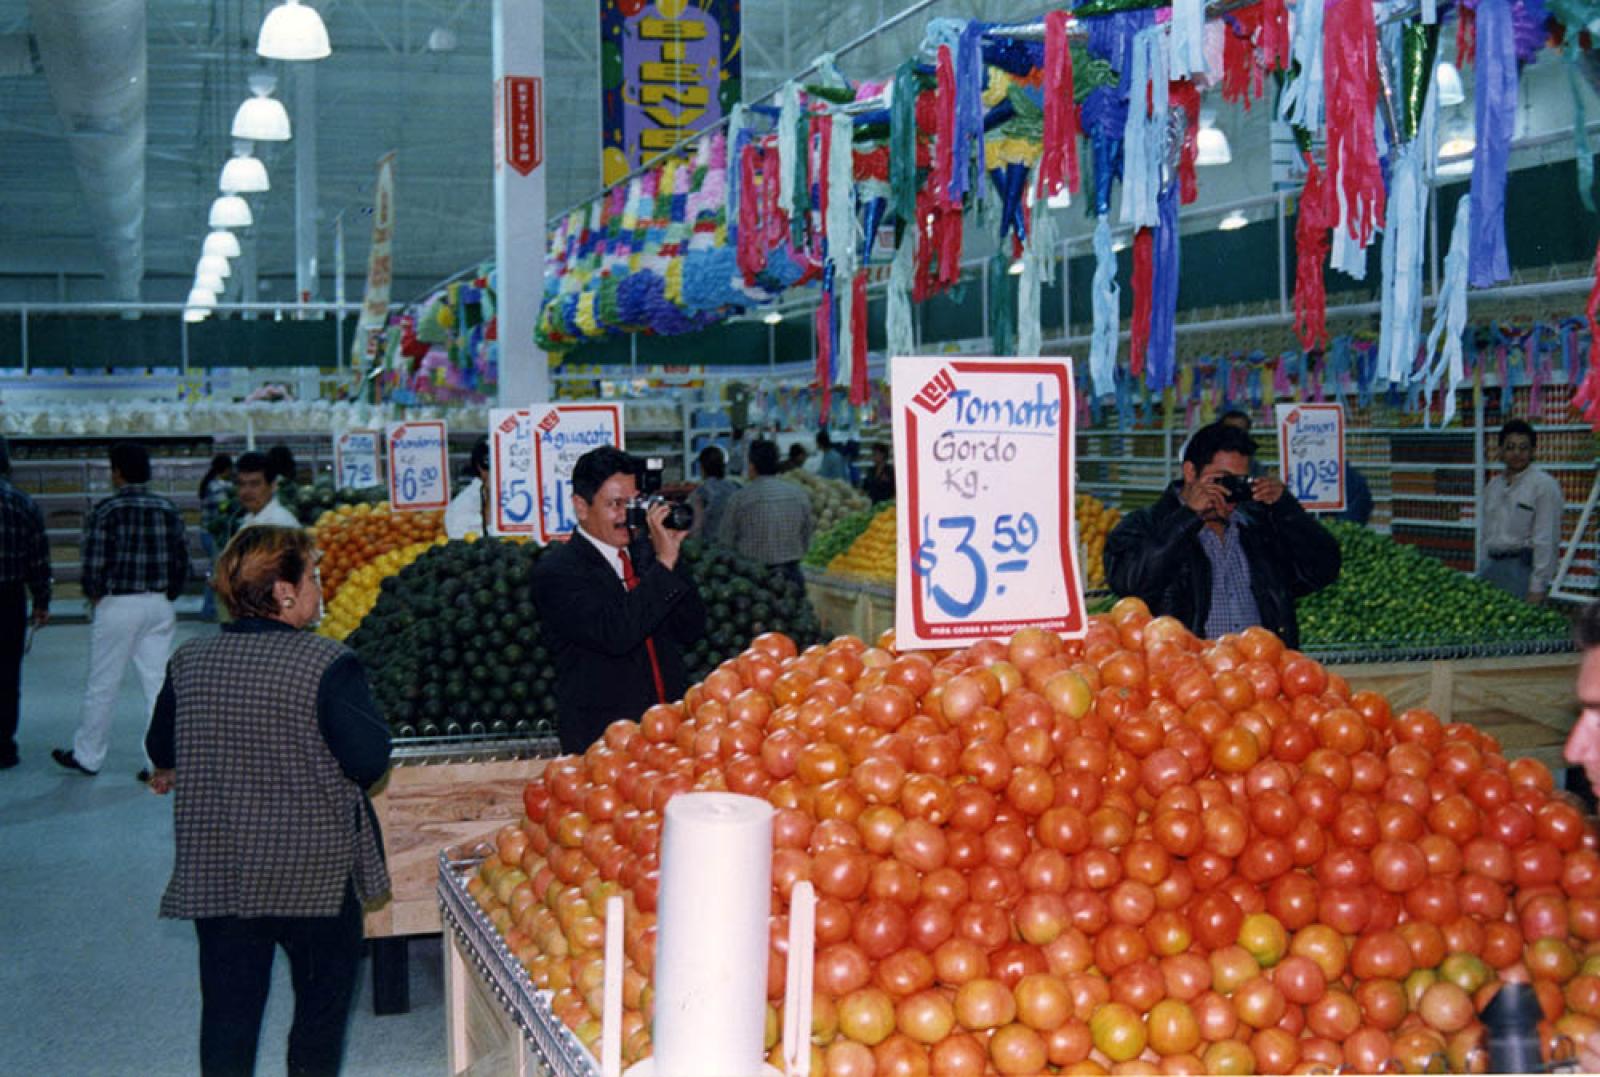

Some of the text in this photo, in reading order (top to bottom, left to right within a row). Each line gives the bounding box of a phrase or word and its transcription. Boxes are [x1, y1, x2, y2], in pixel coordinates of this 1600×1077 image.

[947, 382, 1060, 427] Tomate
[516, 420, 531, 440] Li
[933, 431, 1018, 462] Gordo
